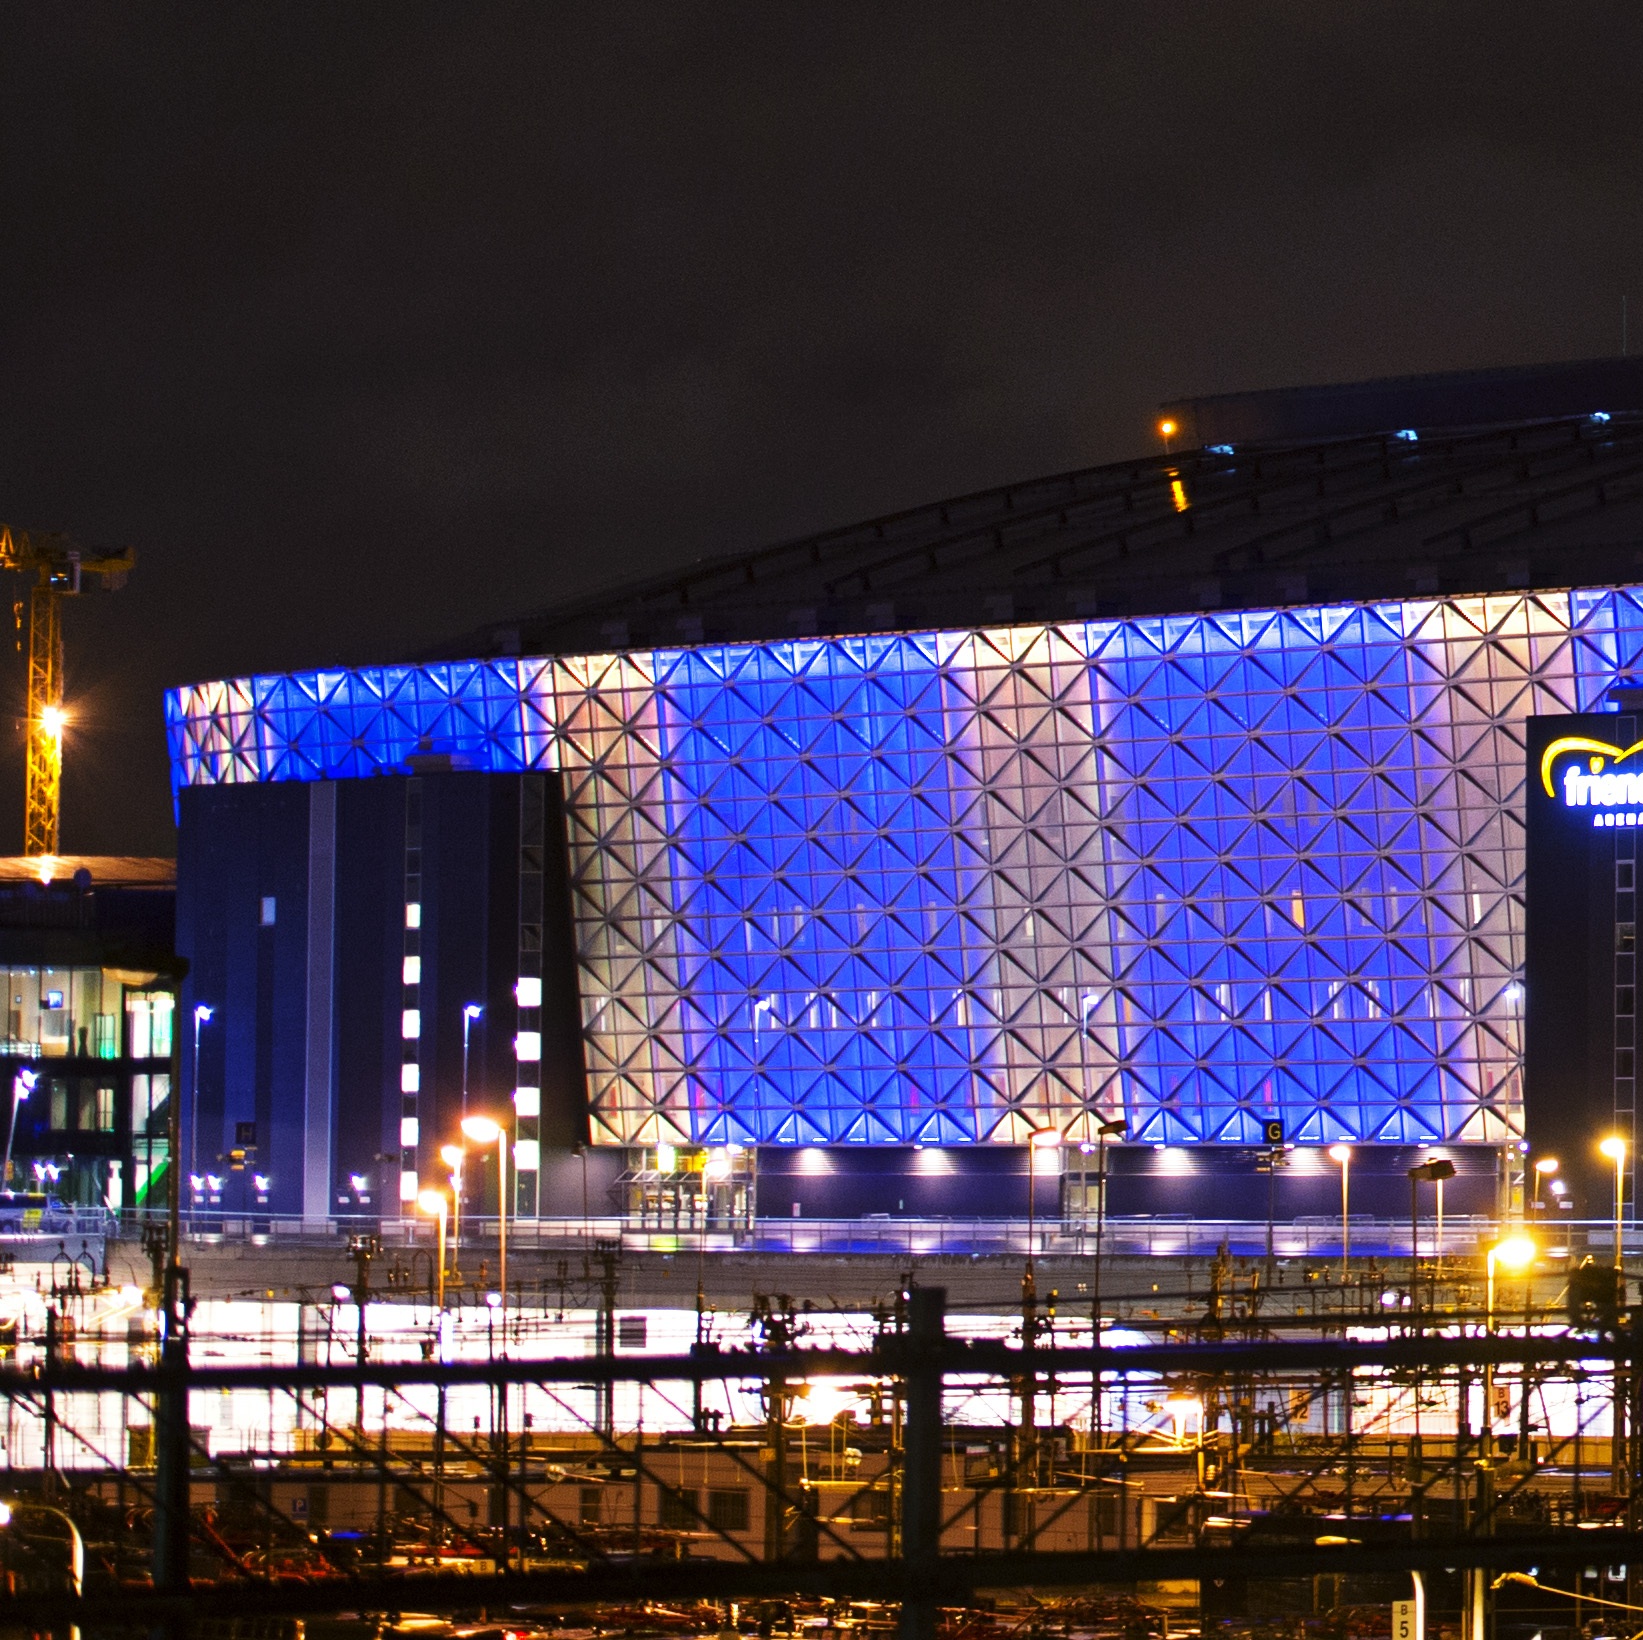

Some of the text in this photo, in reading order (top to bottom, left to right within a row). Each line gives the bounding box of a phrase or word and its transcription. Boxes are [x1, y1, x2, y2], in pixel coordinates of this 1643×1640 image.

[1268, 1123, 1281, 1140] G
[1494, 1401, 1508, 1419] 13
[1400, 1604, 1408, 1616] B
[1400, 1620, 1409, 1638] 5
